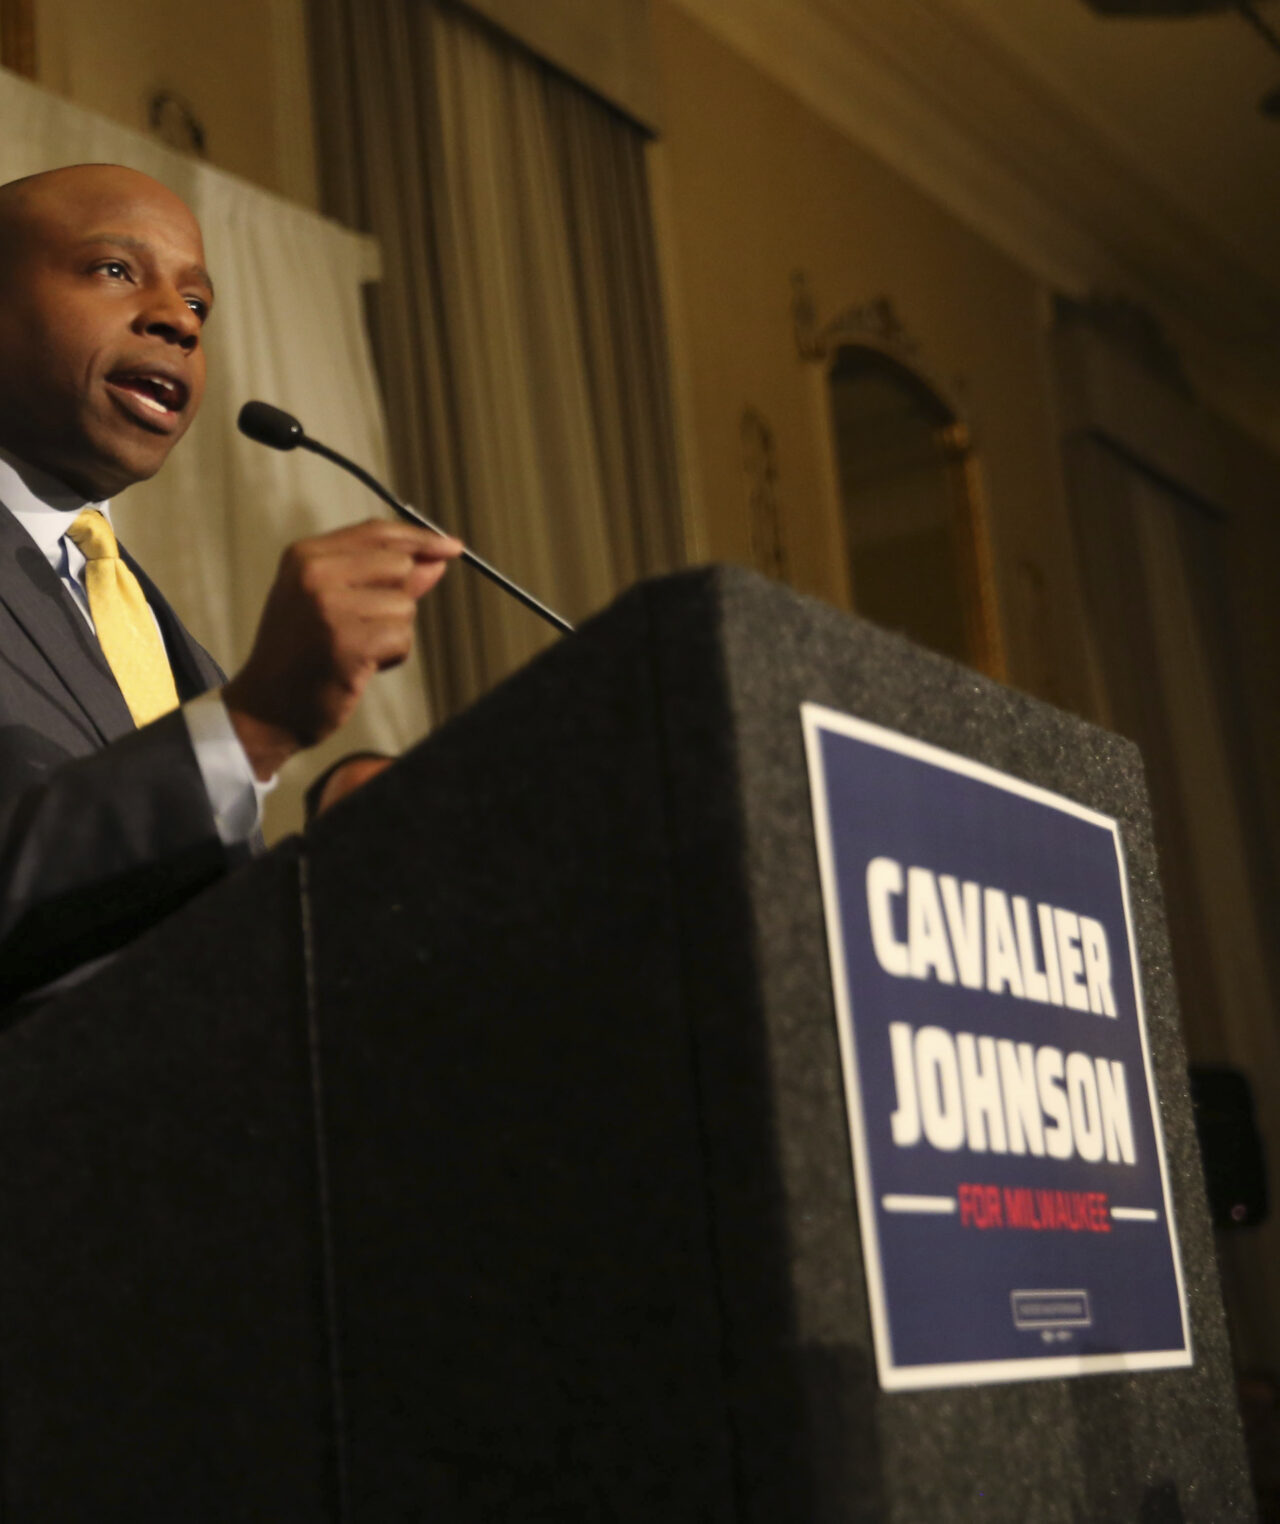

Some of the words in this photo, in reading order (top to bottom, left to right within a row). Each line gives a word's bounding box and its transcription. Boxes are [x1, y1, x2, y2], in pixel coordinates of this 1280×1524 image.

[866, 856, 1117, 1019] CAVALIER
[888, 1021, 1136, 1165] JOHNSON
[958, 1183, 1003, 1230] FOR
[1004, 1186, 1112, 1232] MILWAUKEE
